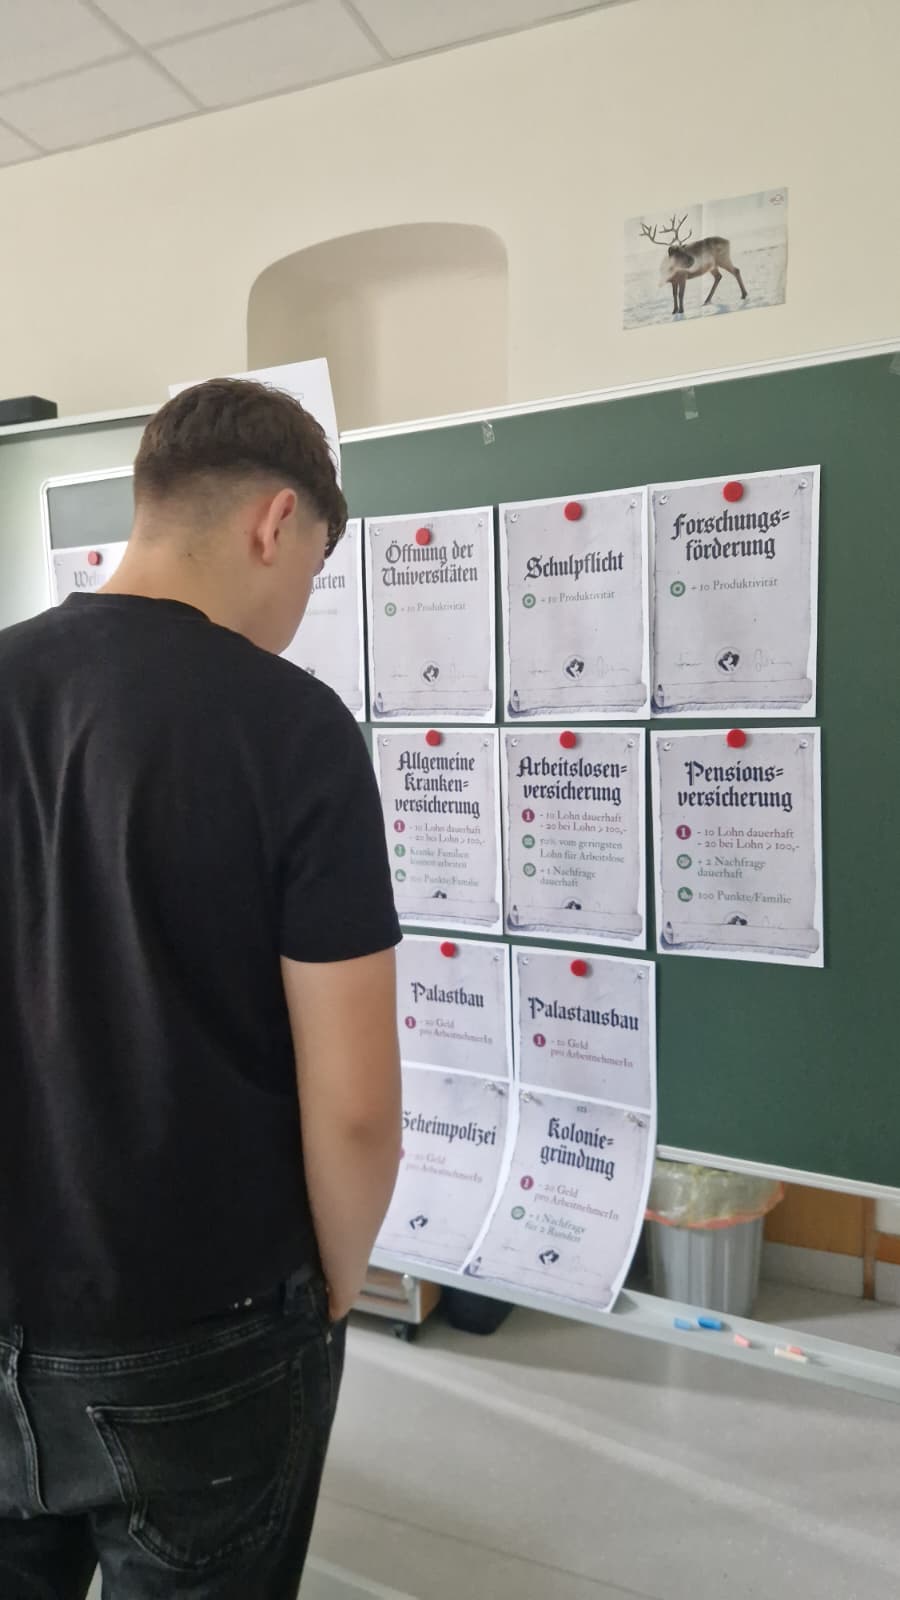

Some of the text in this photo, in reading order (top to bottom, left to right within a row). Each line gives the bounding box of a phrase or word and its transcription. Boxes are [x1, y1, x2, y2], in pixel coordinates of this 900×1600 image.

[385, 540, 475, 567] Öffnung der
[686, 537, 776, 561] förderung
[523, 551, 625, 581] Schulpflicht
[381, 565, 478, 586] Universitäten
[713, 577, 778, 590] Produktivität
[559, 591, 615, 602] Produktivität
[397, 751, 475, 774] Allgemeine
[523, 780, 622, 806] versicherung
[677, 786, 793, 813] versicherung
[395, 795, 480, 819] versicherung
[557, 810, 580, 820] Lohn
[581, 810, 622, 823] dauerhaft
[425, 823, 445, 832] Lohn
[446, 823, 481, 834] dauerhaft
[558, 821, 571, 831] bei
[573, 821, 596, 832] Lohn
[704, 829, 715, 837] 10
[717, 826, 744, 837] Lohn
[746, 827, 794, 839] dauerhaft
[439, 833, 459, 843] Lohn
[559, 839, 577, 847] vom
[578, 839, 623, 851] geringsten
[719, 838, 733, 849] bei
[736, 838, 763, 849] Lohn
[539, 848, 625, 864] Lohn für Arbeitslose
[714, 856, 766, 871] Nachfrage
[553, 866, 597, 880] Nachfrage
[697, 867, 743, 880] dauerhaft
[540, 877, 578, 888] dauerhaft
[698, 890, 792, 904] 100 Punkte/Familie
[411, 981, 485, 1008] Palastbau
[528, 996, 639, 1031] Palastausbau
[436, 1018, 454, 1028] Geld
[567, 1038, 589, 1050] Geld
[550, 1047, 564, 1057] pro
[540, 1144, 615, 1181] gründung
[534, 1193, 549, 1203] pro
[557, 1184, 579, 1198] Geld
[542, 1212, 586, 1234] Nachfrage
[547, 1226, 581, 1243] Runden
